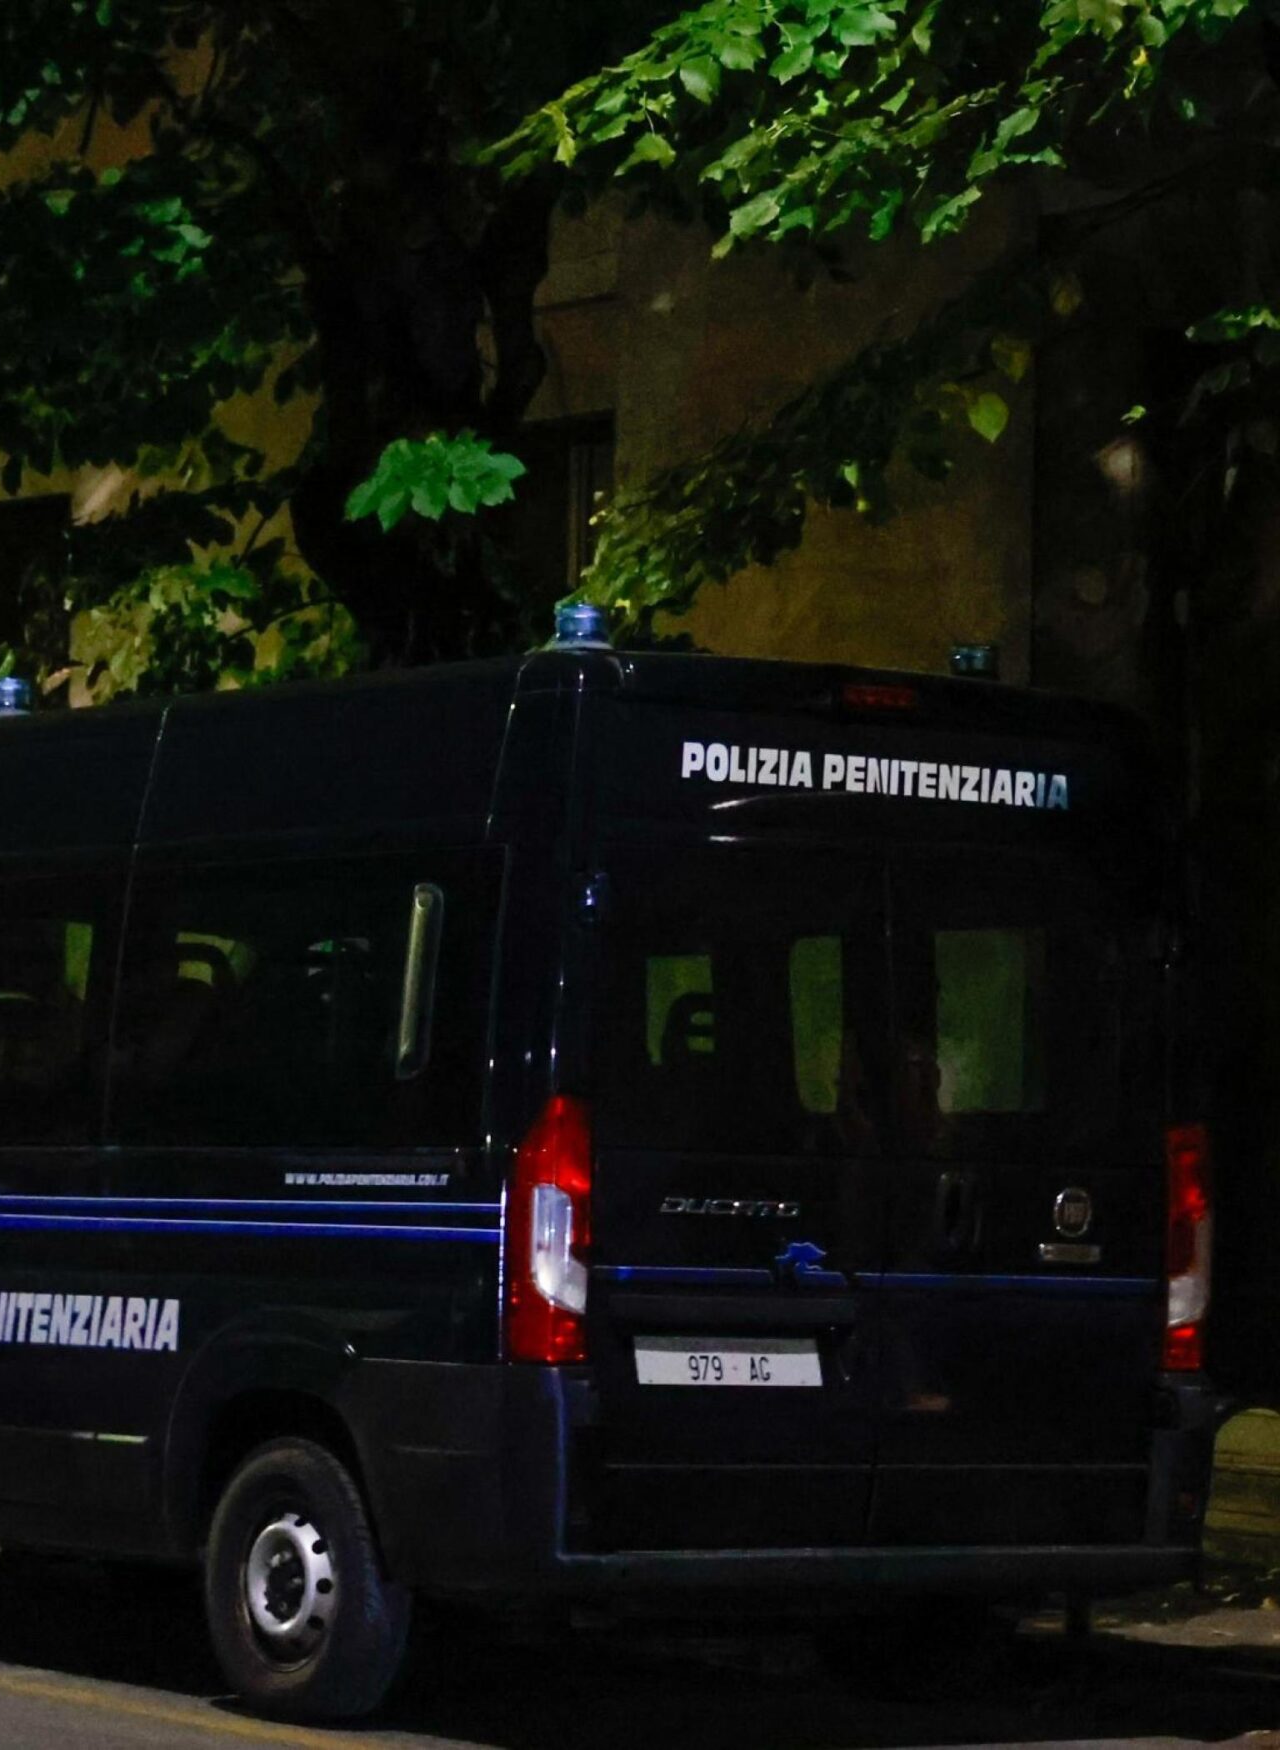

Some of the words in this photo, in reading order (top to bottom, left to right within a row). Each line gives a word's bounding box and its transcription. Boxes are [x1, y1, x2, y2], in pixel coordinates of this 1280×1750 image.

[681, 741, 813, 788] POLIZIA
[822, 753, 1068, 810] PENITENZIARIA
[688, 1355, 723, 1381] 979
